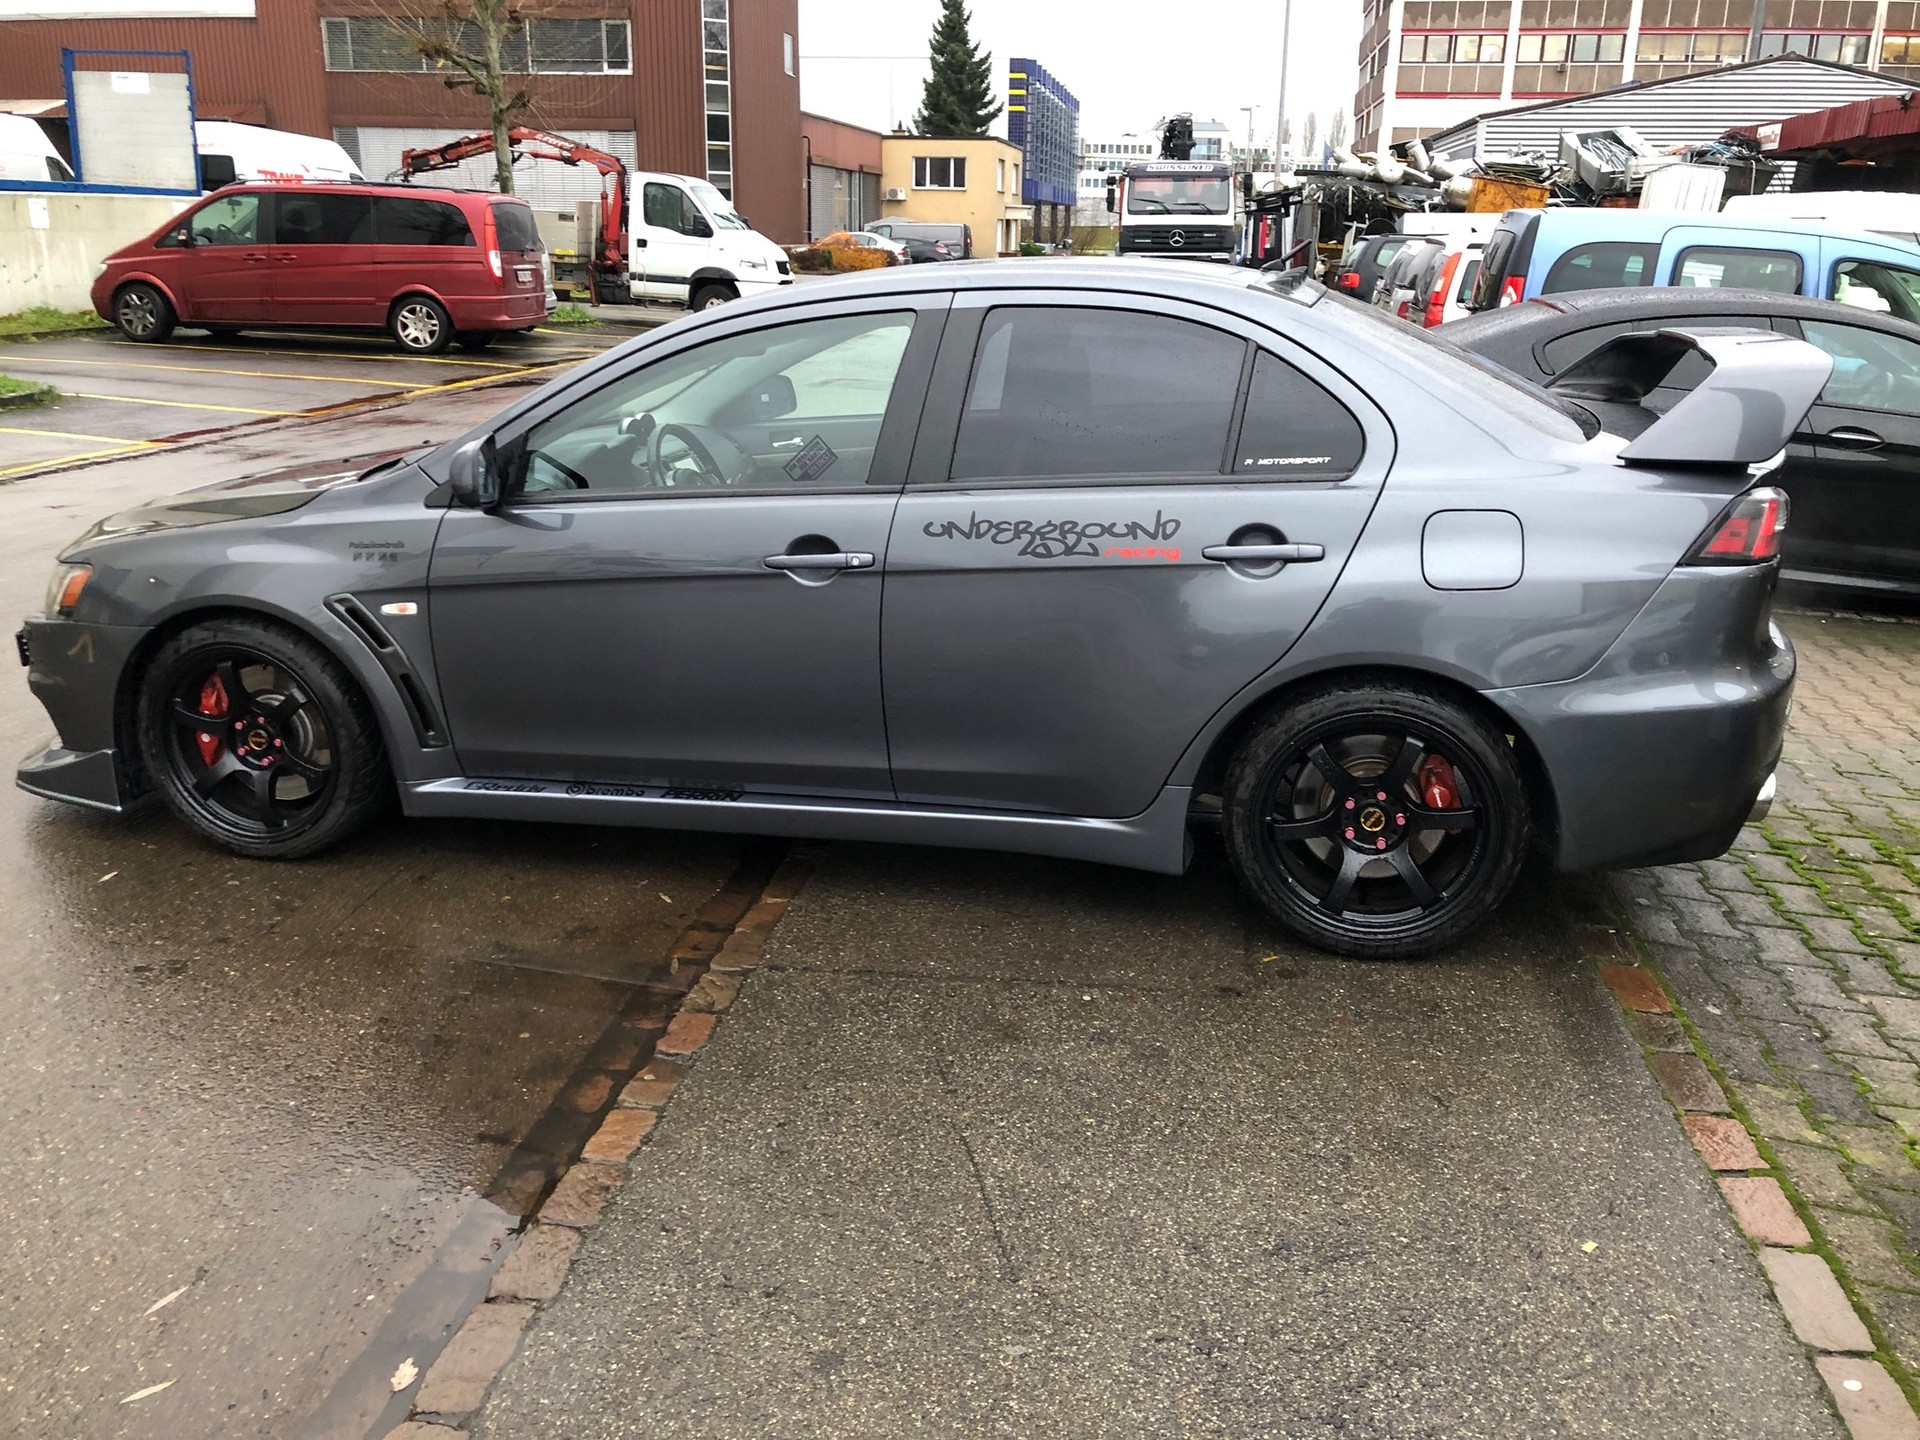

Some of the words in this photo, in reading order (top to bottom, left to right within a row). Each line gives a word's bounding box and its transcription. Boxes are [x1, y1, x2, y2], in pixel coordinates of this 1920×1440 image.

[1148, 163, 1212, 171] SWISSLINER
[1257, 457, 1331, 465] MOTORSPORT
[923, 509, 1181, 558] UNDERGROUND
[1105, 547, 1181, 561] racing
